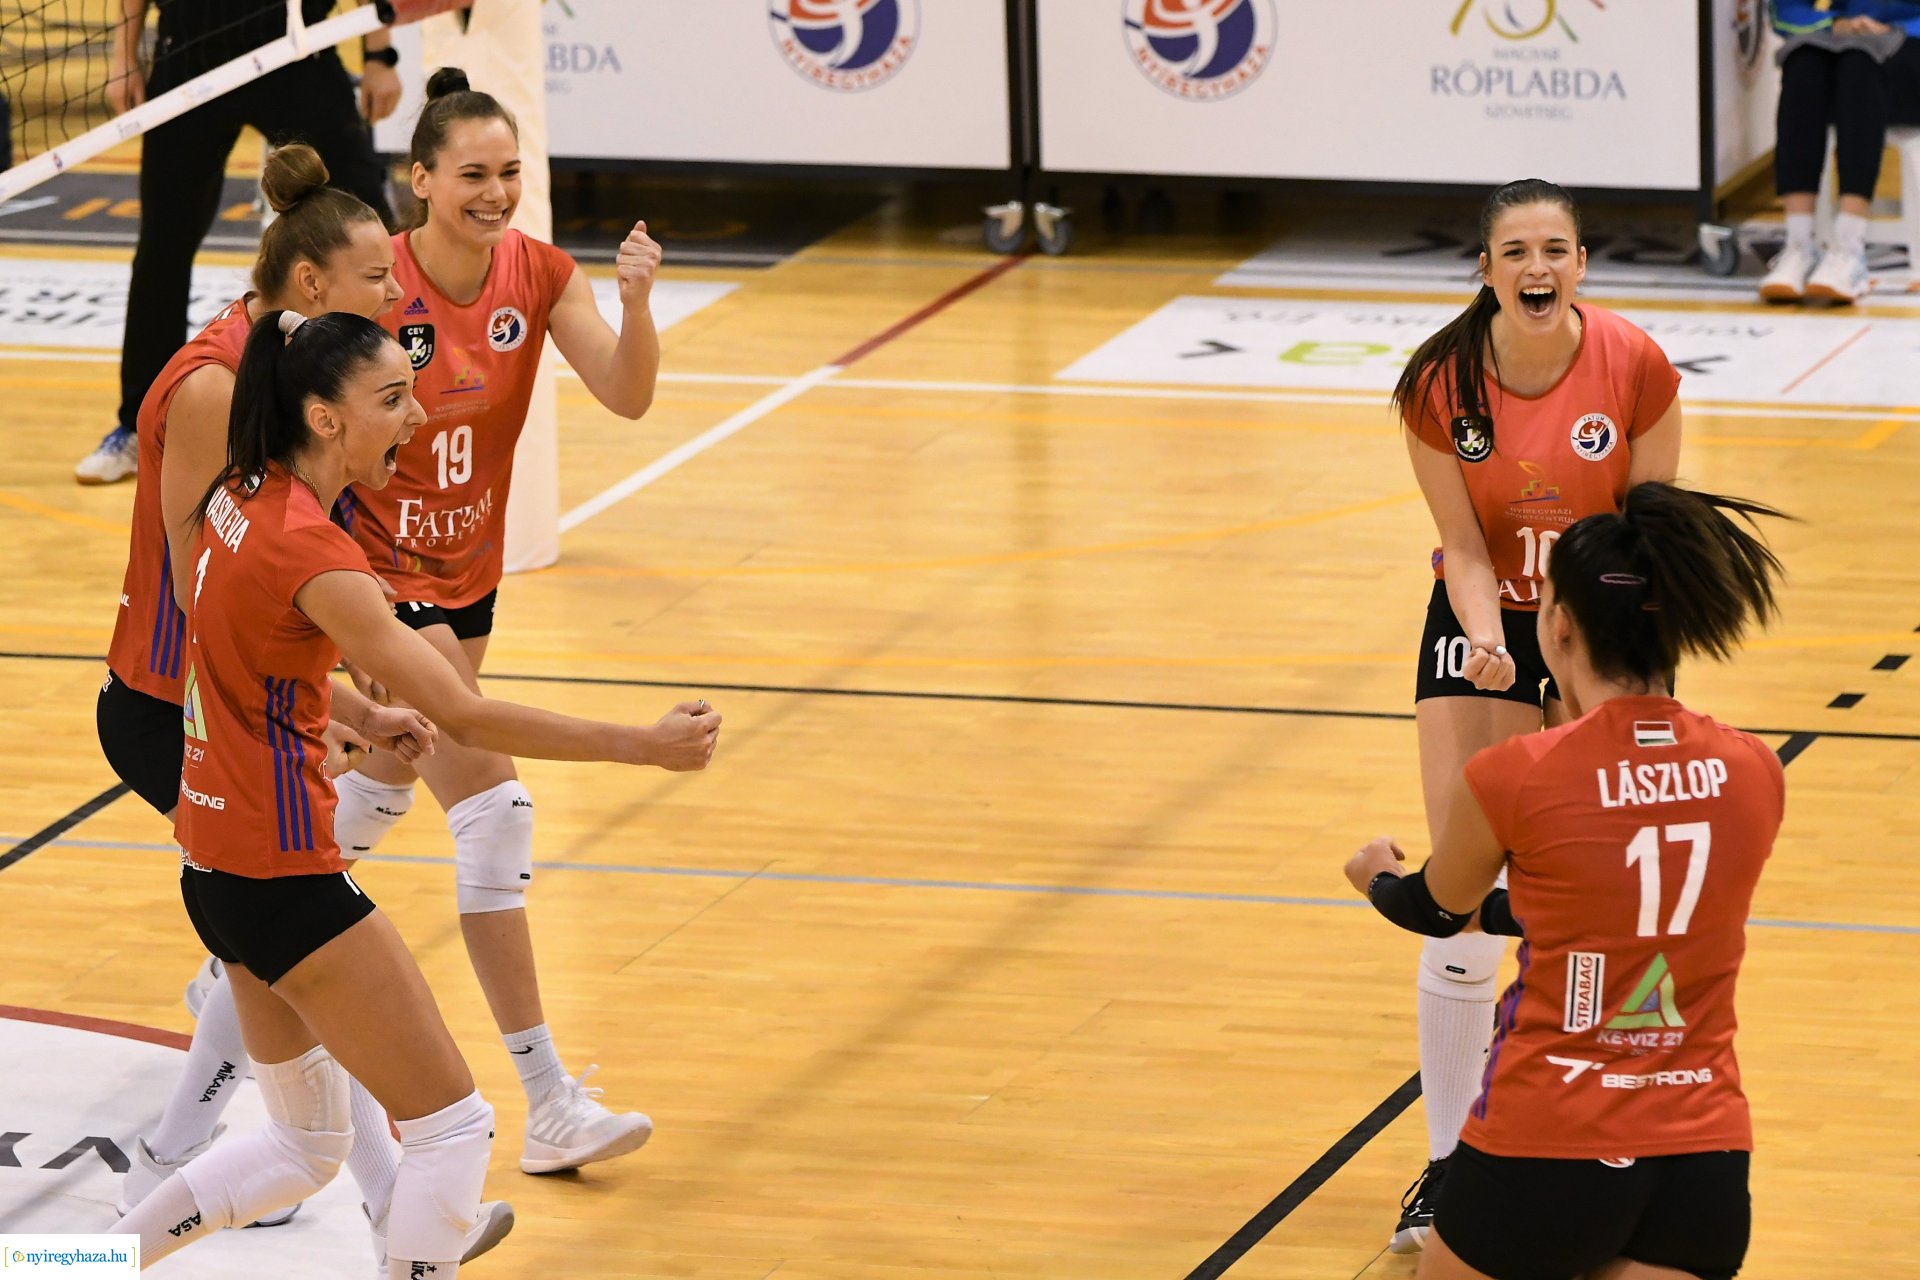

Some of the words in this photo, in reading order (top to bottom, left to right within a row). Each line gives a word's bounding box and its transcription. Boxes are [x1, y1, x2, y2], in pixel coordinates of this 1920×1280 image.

[407, 327, 425, 335] CEV
[431, 425, 473, 490] 19
[205, 486, 250, 554] VASILEVA
[1434, 635, 1471, 679] 10
[192, 747, 205, 762] 21
[1597, 758, 1728, 808] LÁSZLOP
[1625, 821, 1711, 937] 17
[1576, 956, 1593, 1028] STRABAG
[1596, 1030, 1660, 1047] KE-VIZ
[1662, 1031, 1684, 1047] 21
[198, 1061, 236, 1103] MIKASA
[1601, 1067, 1713, 1089] BESTRONG
[168, 1211, 202, 1238] ASA
